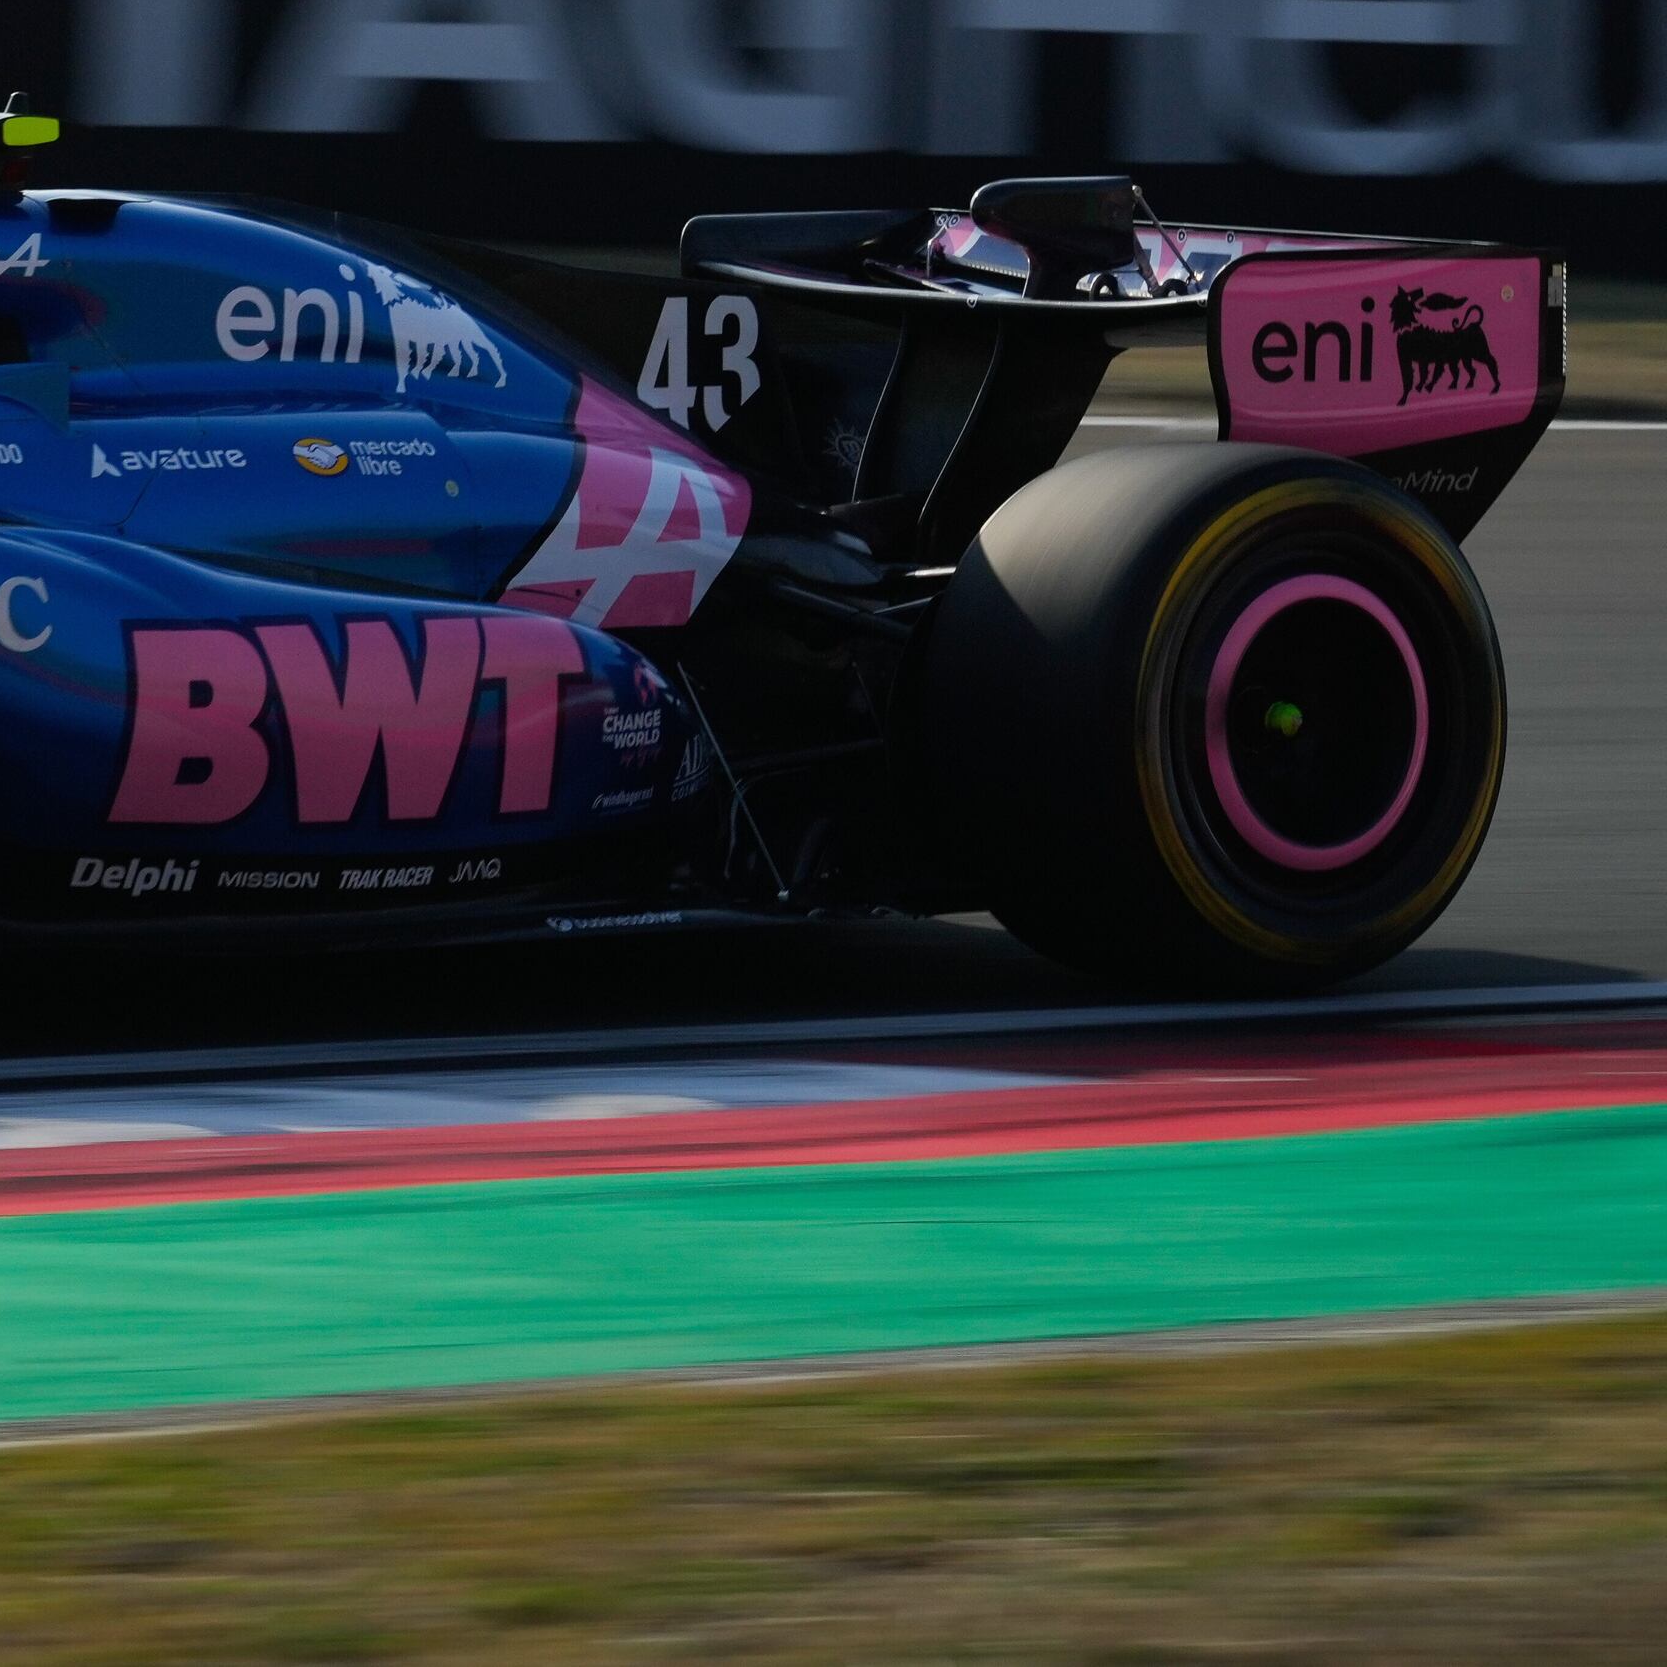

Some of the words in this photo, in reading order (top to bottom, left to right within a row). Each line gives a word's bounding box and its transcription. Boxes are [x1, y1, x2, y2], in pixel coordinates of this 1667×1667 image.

[216, 263, 364, 364] eni
[1252, 297, 1374, 385] eni
[637, 295, 761, 433] 43
[122, 446, 247, 472] avature
[349, 438, 436, 460] mercado
[356, 454, 403, 476] libre
[104, 613, 586, 827] BWT
[603, 708, 662, 733] CHANGE
[614, 728, 661, 749] WORLD
[69, 856, 200, 897] Delphi
[217, 871, 321, 889] MISSION
[338, 868, 380, 889] TRAK
[381, 865, 434, 887] RACER
